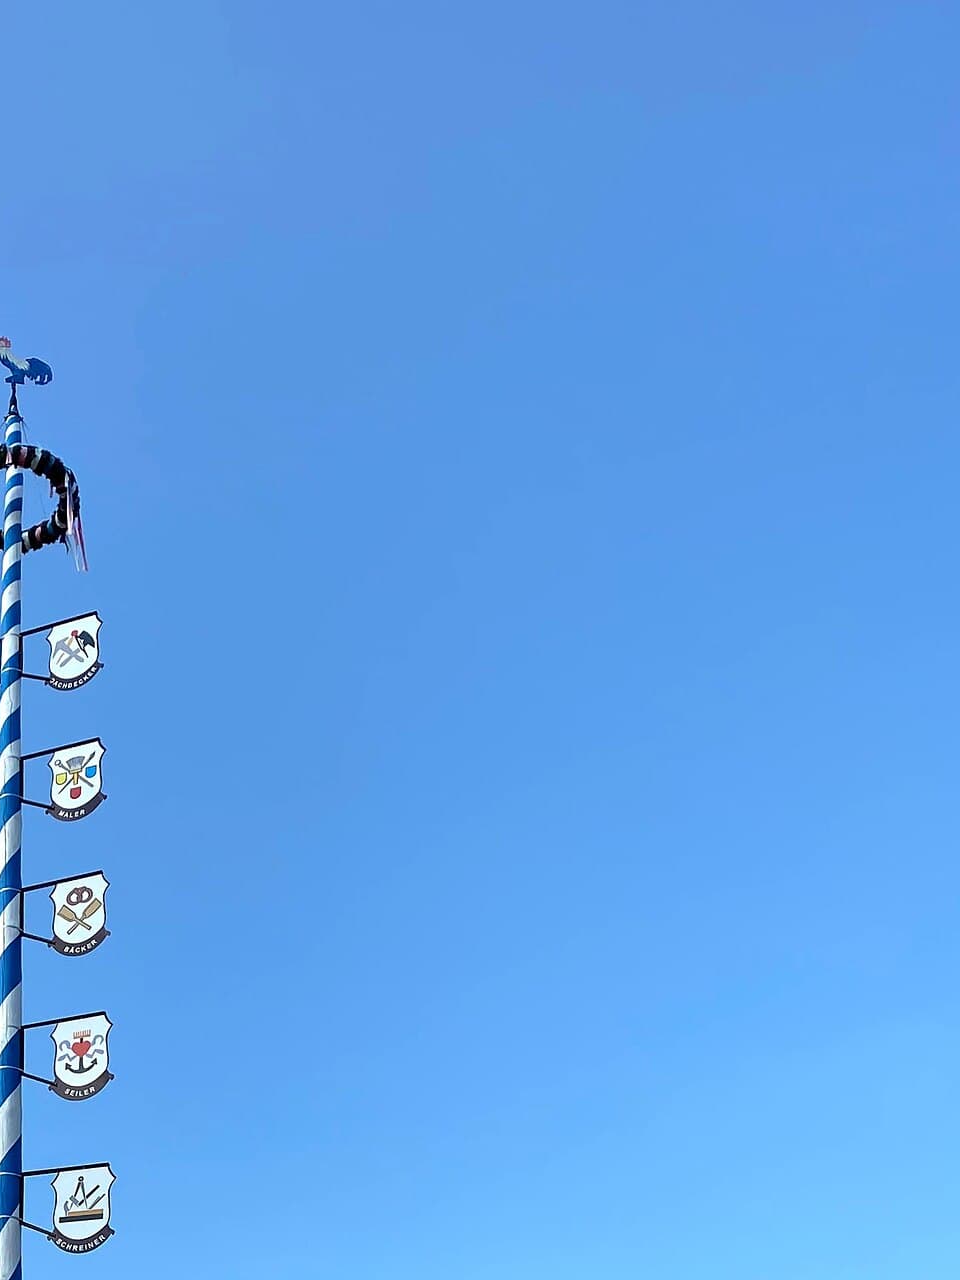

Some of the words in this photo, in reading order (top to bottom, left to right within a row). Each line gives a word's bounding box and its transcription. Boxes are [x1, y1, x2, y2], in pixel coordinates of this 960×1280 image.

[58, 809, 86, 819] MALER
[64, 1086, 97, 1098] SEILER
[56, 1234, 106, 1252] SCHREINER
